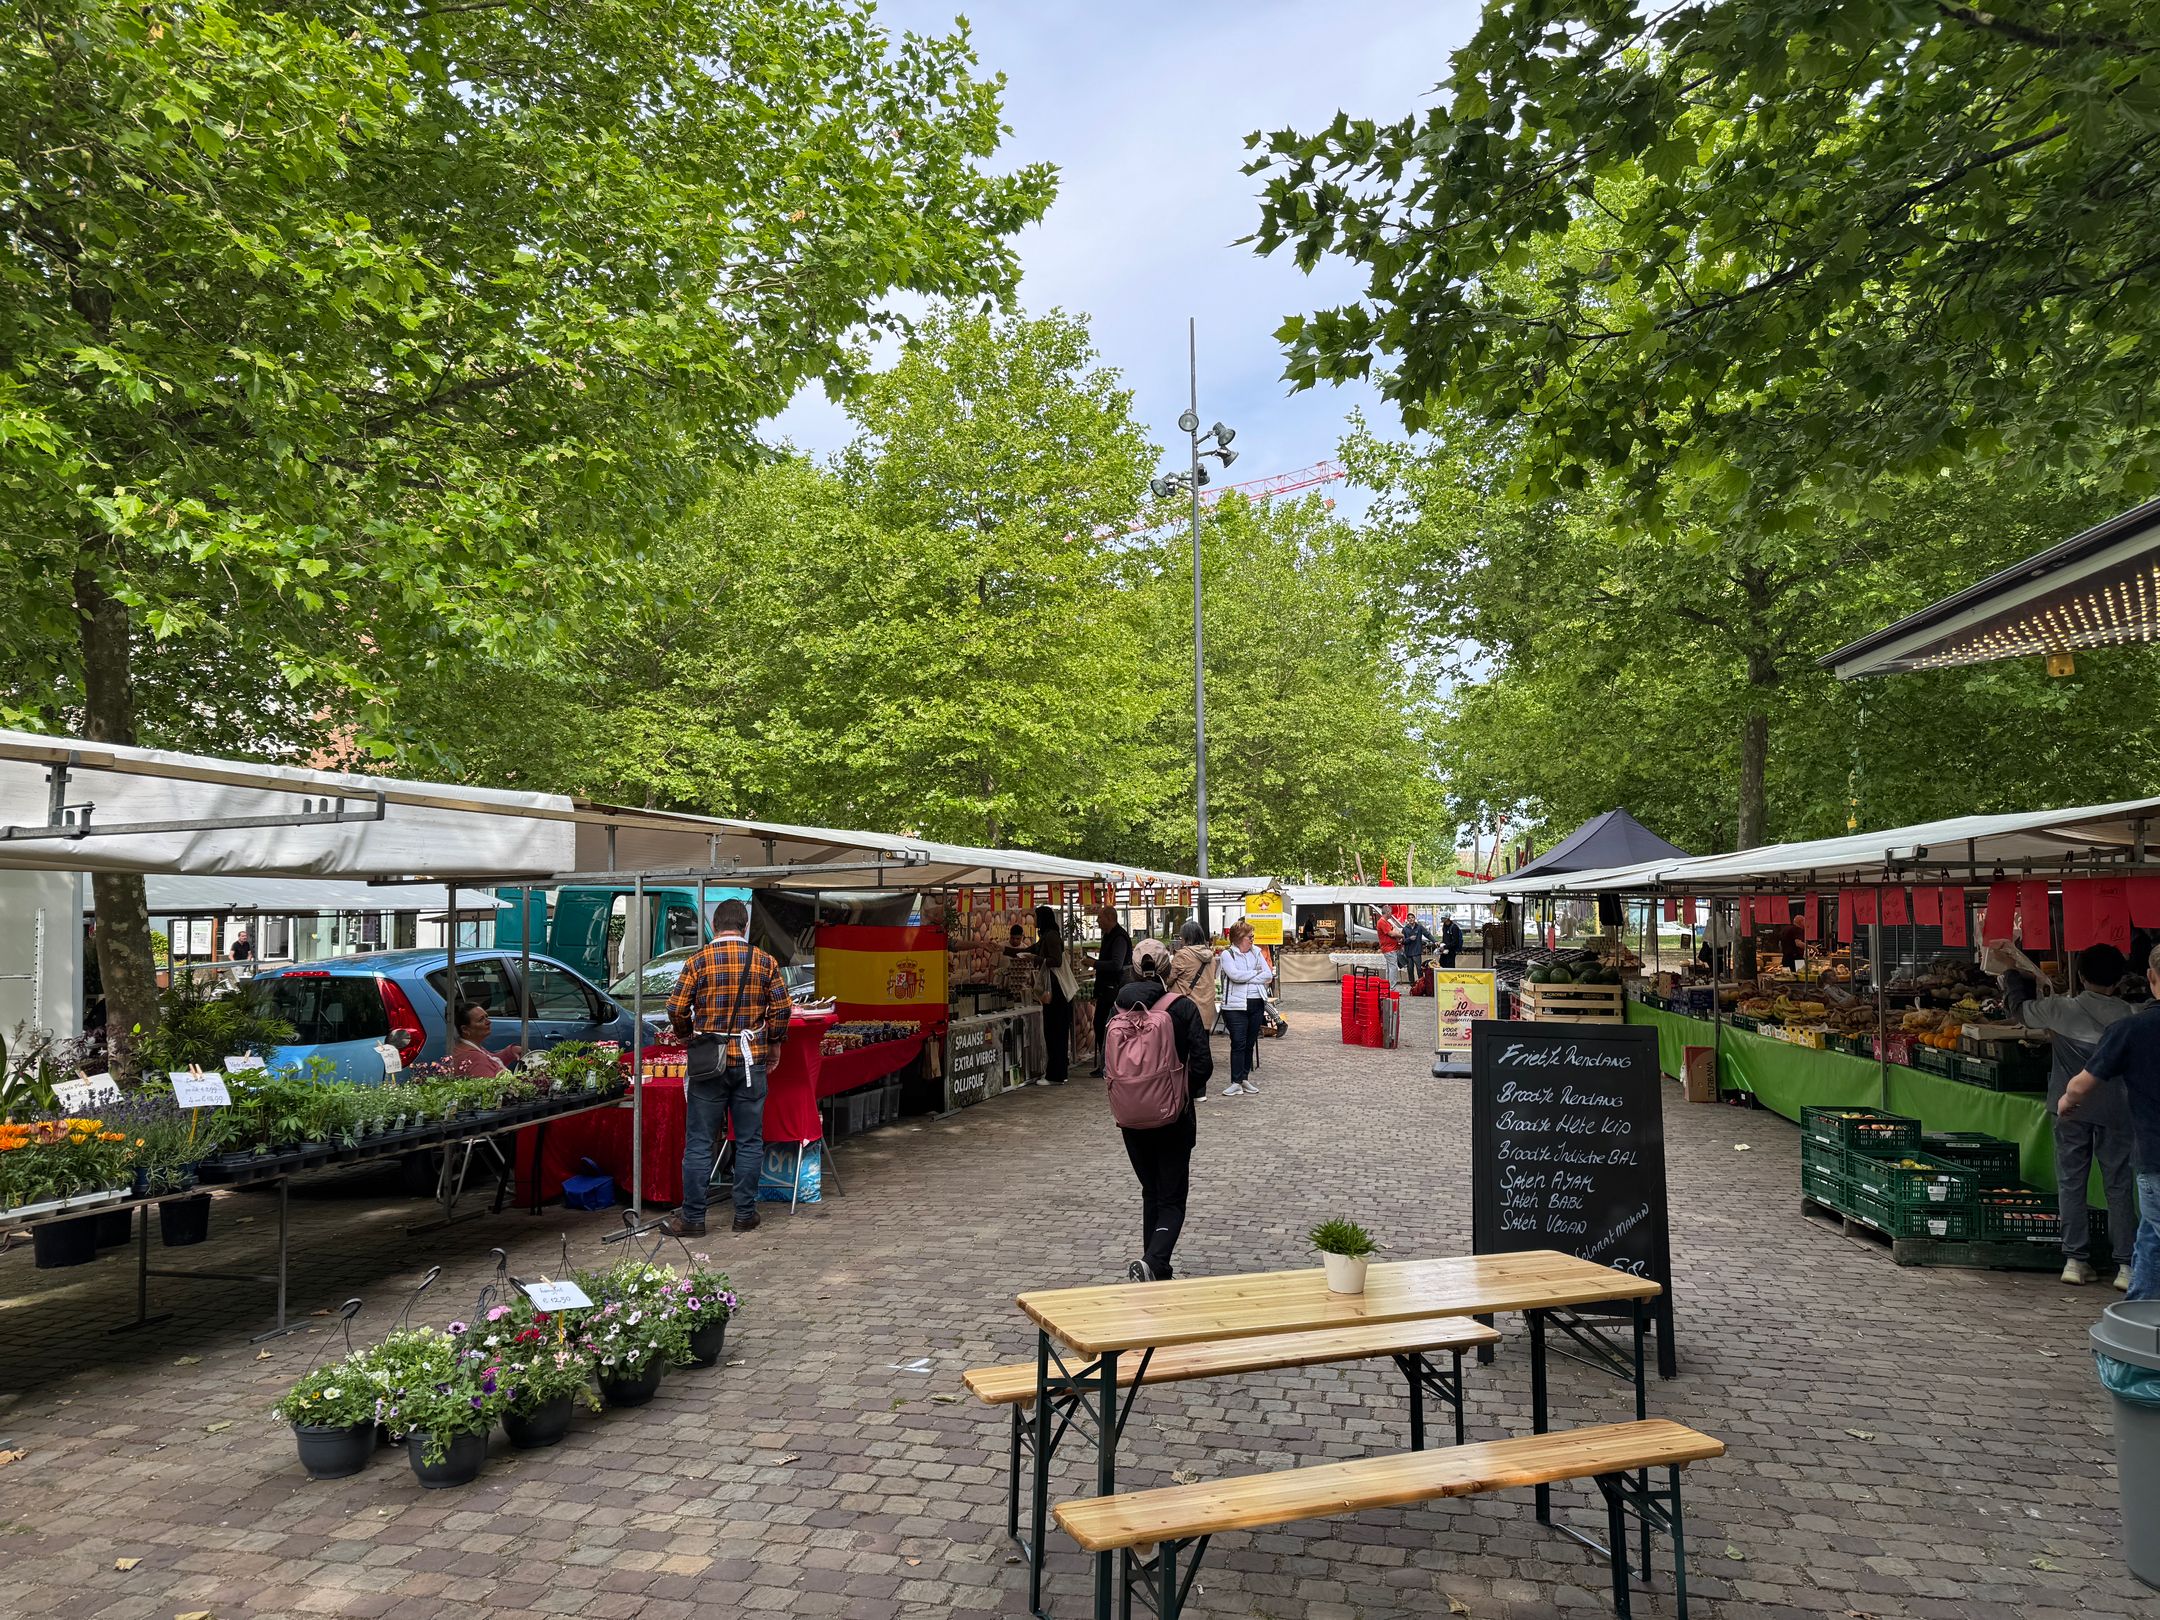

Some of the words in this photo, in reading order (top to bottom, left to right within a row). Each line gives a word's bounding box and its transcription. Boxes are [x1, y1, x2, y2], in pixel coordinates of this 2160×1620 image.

[1444, 1009, 1485, 1017] DAGVERSE
[1457, 1001, 1468, 1010] 10
[955, 1031, 984, 1051] SPAANSE
[954, 1054, 974, 1072] EXTRA
[975, 1048, 997, 1067] VIERGE
[953, 1072, 985, 1094] OLIJFOLIE
[1607, 1149, 1638, 1166] BAL
